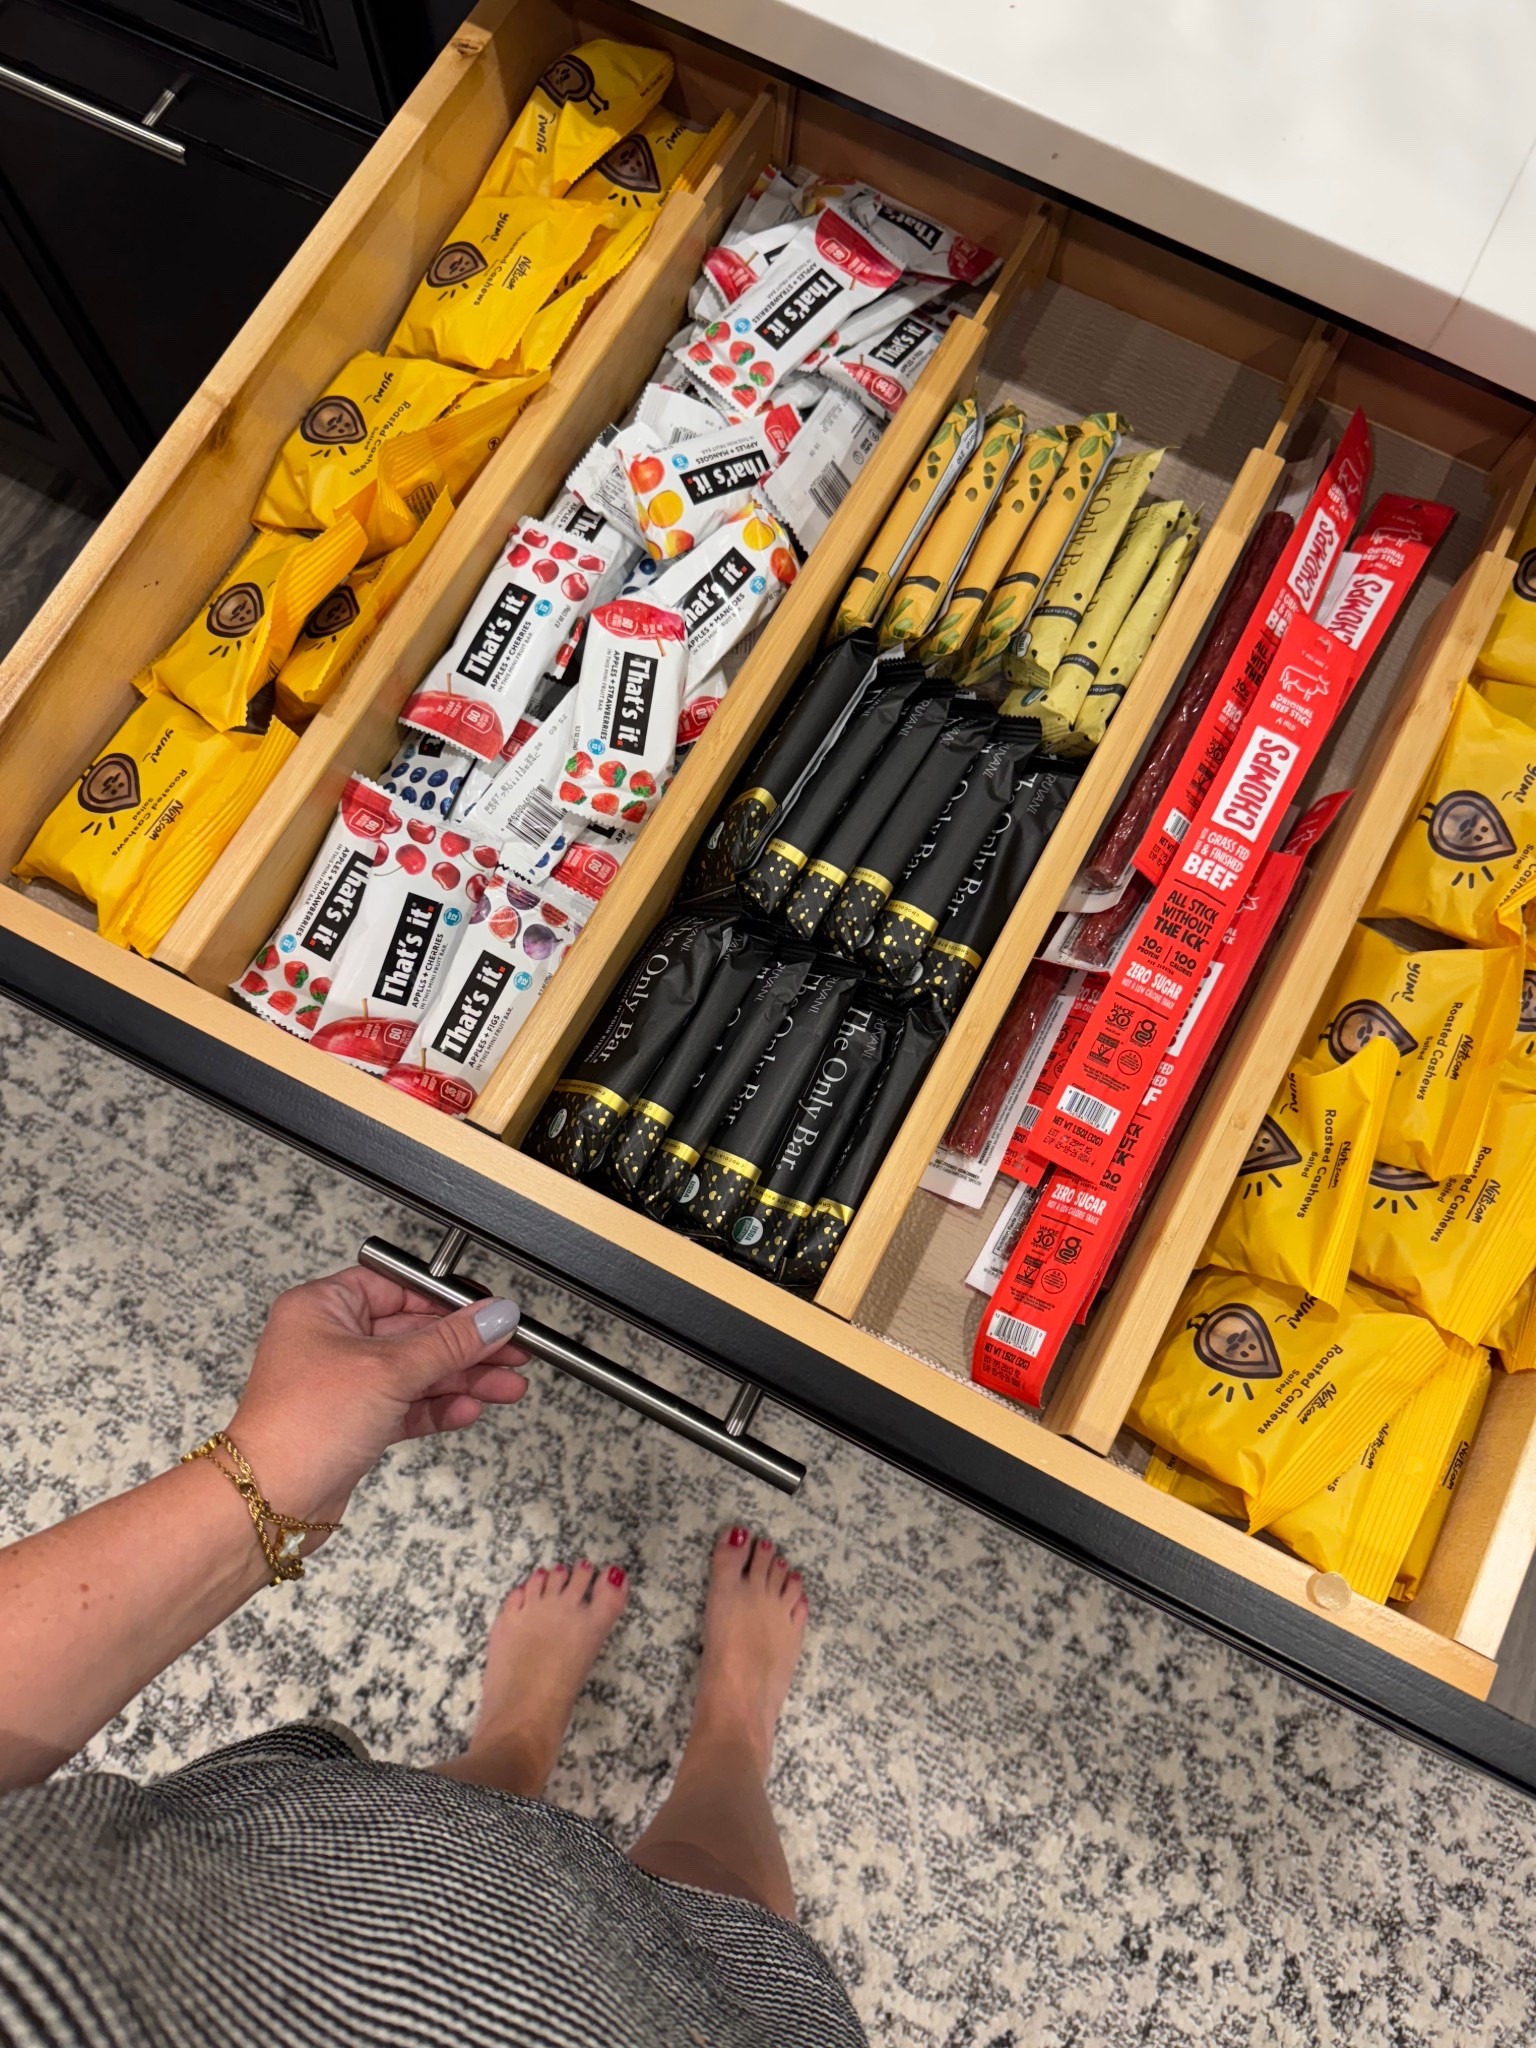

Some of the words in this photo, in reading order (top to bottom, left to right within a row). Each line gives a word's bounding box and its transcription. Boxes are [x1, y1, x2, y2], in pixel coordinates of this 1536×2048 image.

[473, 265, 503, 306] Cashews
[784, 270, 837, 321] That's
[875, 327, 914, 369] That's
[379, 400, 411, 438] Roasted
[350, 440, 382, 476] Cashews
[695, 449, 729, 464] MANGOES
[734, 440, 759, 452] APPLES
[713, 457, 769, 487] That's
[1100, 452, 1133, 496] The
[559, 500, 577, 525] APPLES
[1071, 492, 1112, 550] Only
[1048, 543, 1084, 591] Bar
[1293, 519, 1338, 602] CHOMPS
[1325, 572, 1384, 646] CHOMPS
[464, 617, 511, 676] That's
[489, 661, 508, 689] APPLES
[507, 619, 532, 656] CHERRIES
[684, 626, 710, 650] APPLES
[609, 649, 620, 677] APPLES
[622, 658, 651, 719] That's
[1273, 692, 1315, 720] ORIGINAL
[466, 707, 482, 723] 60
[599, 684, 614, 740] STRAWBERRIES
[1268, 699, 1290, 716] BEEF
[1287, 708, 1313, 728] STICK
[152, 769, 187, 810] Roasted
[1222, 737, 1291, 832] CHOMPS
[132, 798, 154, 820] Salted
[150, 799, 184, 841] Nuts.com
[112, 812, 151, 856] Cashews
[1205, 828, 1238, 854] GRASS
[1233, 843, 1252, 862] FED
[330, 846, 350, 875] APPLES
[586, 859, 602, 872] 60
[1180, 849, 1240, 895] BEEF
[1199, 842, 1211, 856] &
[1207, 846, 1245, 874] FINISHED
[1513, 843, 1534, 872] Salted
[294, 879, 330, 937] STRAWBERRIES
[326, 861, 375, 922] That's
[1166, 888, 1190, 909] ALL
[1186, 897, 1220, 924] STICK
[1151, 914, 1183, 940] THE
[1158, 901, 1214, 938] WITHOUT
[381, 933, 423, 997] That's
[409, 977, 428, 1008] APPLES
[423, 932, 445, 971] CHERRIES
[432, 956, 443, 974] FRUIT
[1124, 959, 1154, 986] ZERO
[1148, 971, 1185, 1002] SUGAR
[1136, 944, 1160, 961] PROTEIN
[1167, 960, 1194, 978] CALORIES
[1170, 949, 1199, 972] 100
[625, 954, 669, 1012] Only
[387, 1026, 403, 1041] 60
[440, 990, 489, 1053] That's
[466, 1038, 488, 1067] APPLES
[486, 1013, 501, 1032] FIGS
[494, 1018, 507, 1037] FRUIT
[834, 1007, 872, 1050] The
[1437, 1002, 1463, 1048] Roasted
[1417, 1035, 1434, 1061] Salted
[1449, 1034, 1474, 1081] Nuts.com
[799, 1058, 847, 1119] Only
[1416, 1050, 1445, 1101] Cashews
[1051, 1114, 1064, 1127] NET
[1326, 1111, 1343, 1169] Roasted
[682, 1177, 697, 1201] USDA
[1305, 1155, 1323, 1184] Salted
[1336, 1144, 1358, 1195] Nuts.com
[1471, 1150, 1504, 1200] Roasted
[1050, 1181, 1076, 1204] ZERO
[1072, 1189, 1108, 1216] SUGAR
[1300, 1171, 1333, 1226] Cashews
[1446, 1182, 1468, 1210] Salted
[1483, 1184, 1513, 1232] Nuts.com
[1440, 1200, 1477, 1251] Cashews
[1275, 1368, 1300, 1395] Salted
[1301, 1343, 1344, 1391] Roasted
[1257, 1388, 1303, 1435] Cashews
[1299, 1382, 1338, 1425] Nuts.com
[1365, 1422, 1389, 1470] Nuts.com
[1446, 1440, 1470, 1491] Nuts.com
